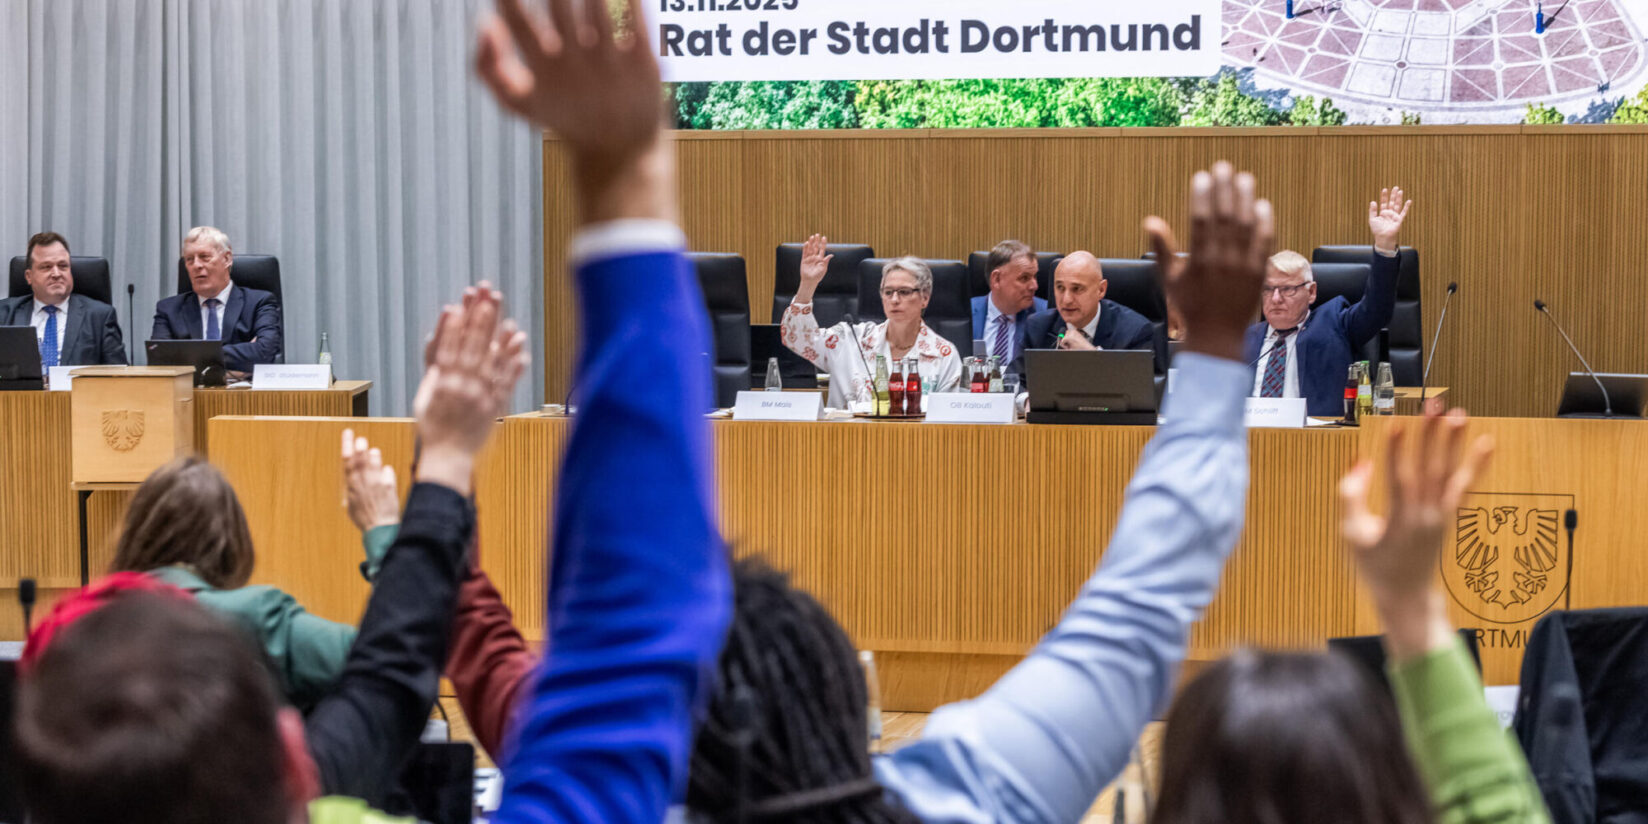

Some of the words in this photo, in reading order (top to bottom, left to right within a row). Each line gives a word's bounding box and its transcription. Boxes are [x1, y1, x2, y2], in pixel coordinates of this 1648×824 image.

[659, 23, 732, 57] Rat
[742, 20, 818, 56] der
[826, 18, 949, 55] Stadt
[960, 14, 1201, 54] Dortmund
